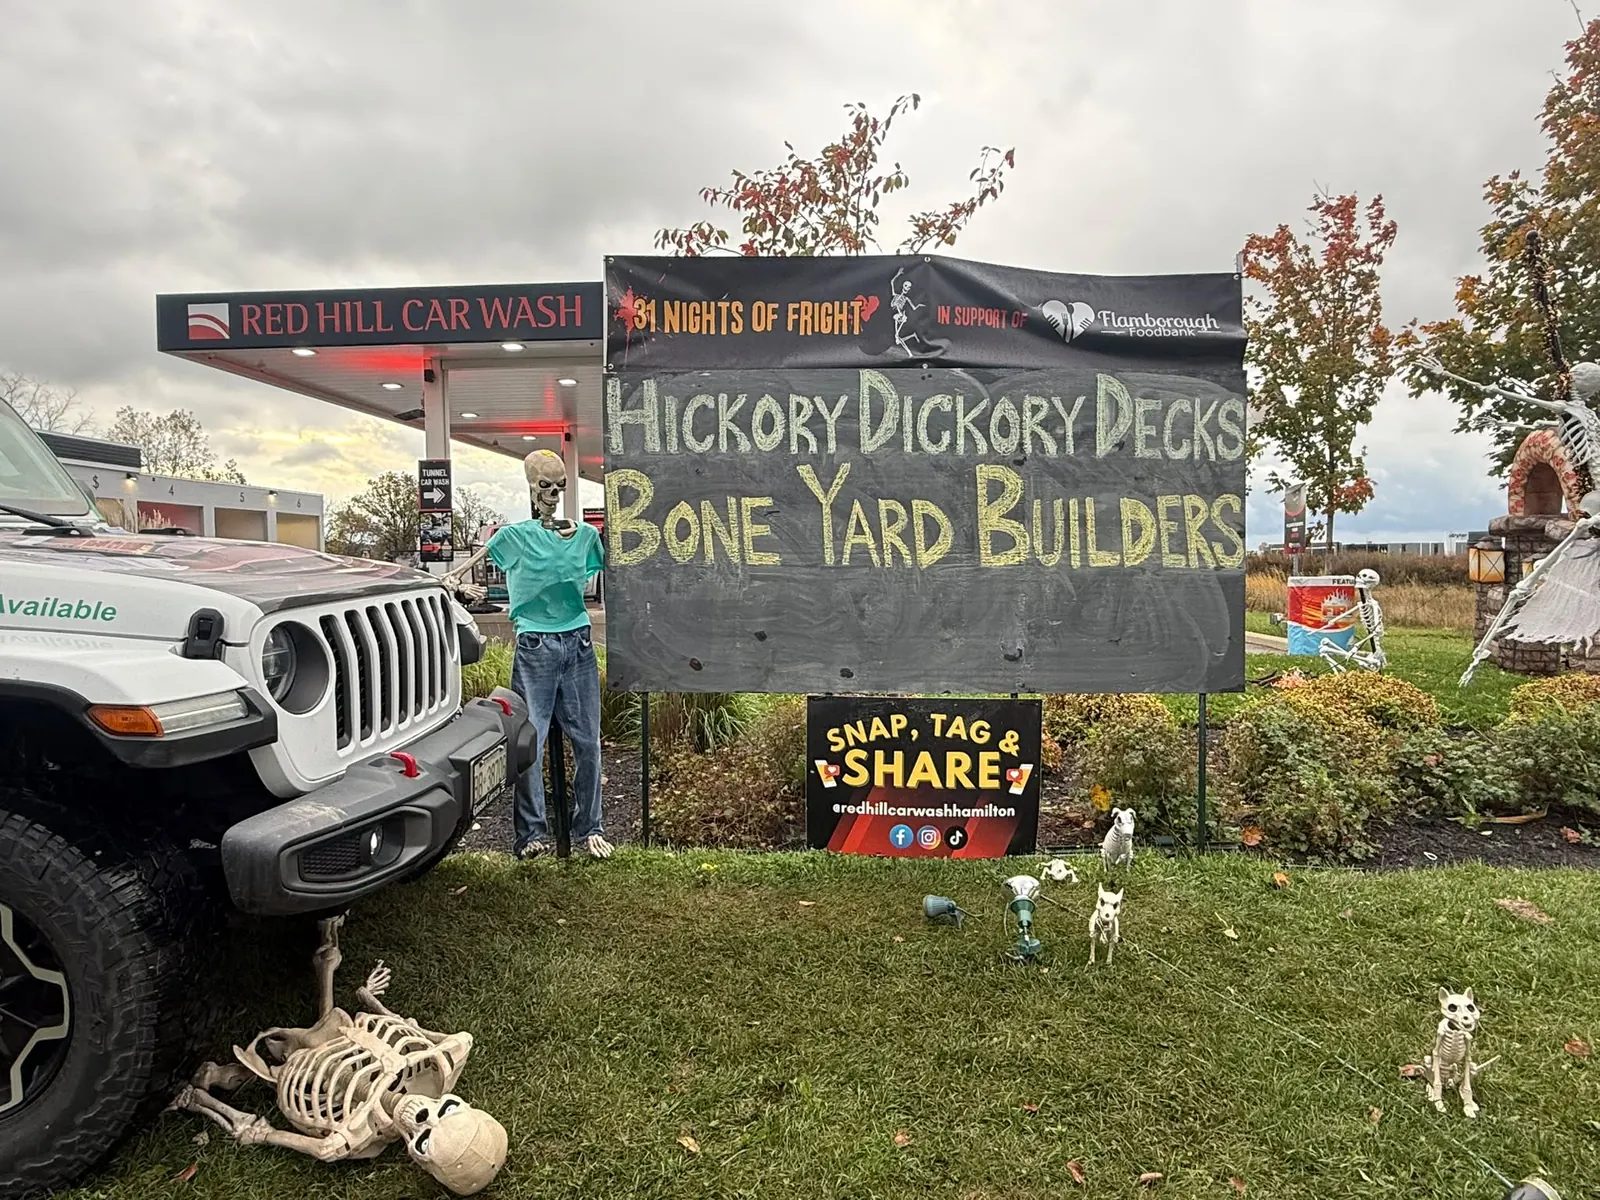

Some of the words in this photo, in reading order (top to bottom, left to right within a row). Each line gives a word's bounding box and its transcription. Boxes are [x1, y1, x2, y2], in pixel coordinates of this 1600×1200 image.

[239, 302, 308, 336] RED
[317, 300, 394, 334] HILL
[402, 297, 471, 331] CAR
[476, 294, 582, 330] WASH
[633, 297, 656, 333] 31
[663, 299, 743, 336] NIGHTS
[751, 300, 779, 332] OF
[787, 300, 864, 336] FRIGHT
[937, 305, 951, 325] IN
[954, 306, 1007, 329] SUPPORT
[1011, 310, 1028, 329] OF
[1098, 310, 1220, 331] Flamborough
[1129, 327, 1196, 337] Foodbank
[606, 377, 848, 455] HICKORY
[859, 368, 1087, 457] DICKORY
[1096, 373, 1245, 461] DECKS
[92, 475, 100, 490] $
[420, 478, 433, 486] CAR
[433, 478, 450, 486] WASH
[422, 469, 448, 477] TUNNEL
[168, 484, 175, 496] 4
[239, 491, 245, 503] 5
[604, 469, 783, 566] BONE
[796, 462, 954, 569] YARD
[976, 463, 1243, 569] BUILDERS
[826, 714, 919, 752] SNAP,
[930, 713, 991, 744] TAG
[998, 730, 1021, 757] &
[841, 748, 1001, 790] SHARE
[832, 801, 1016, 818] @redhillcarwashhamilton
